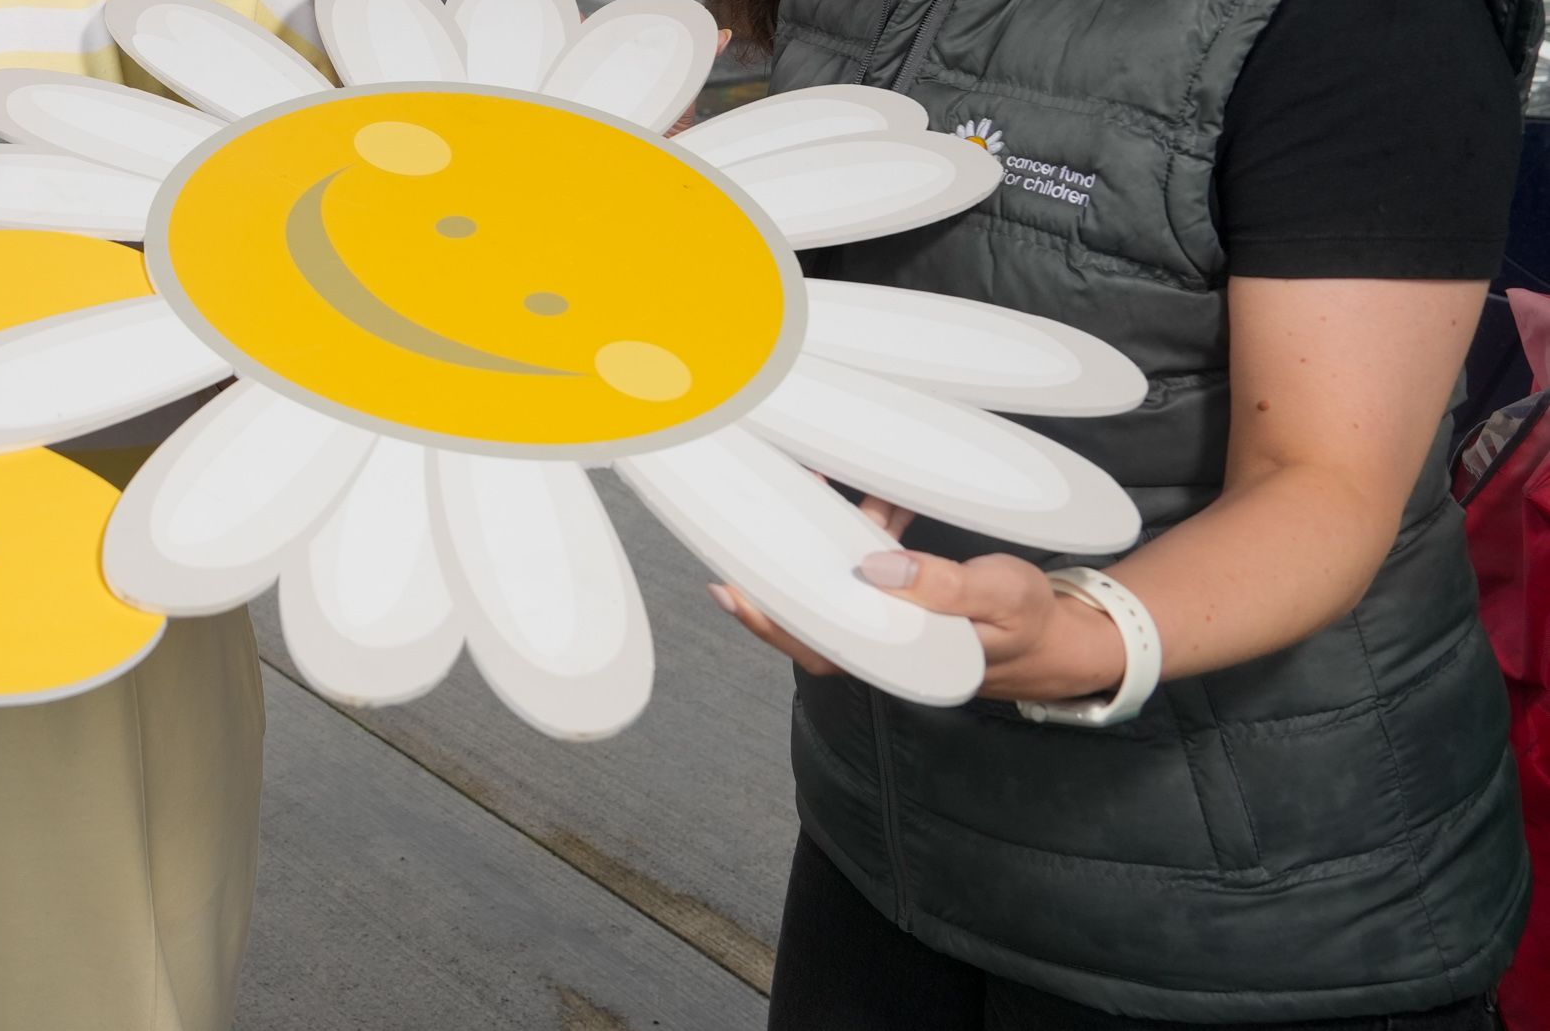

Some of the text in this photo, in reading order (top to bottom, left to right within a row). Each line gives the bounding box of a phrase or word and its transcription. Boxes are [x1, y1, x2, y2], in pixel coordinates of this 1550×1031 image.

[1001, 169, 1090, 207] for children
[1006, 155, 1095, 189] cancer fund
